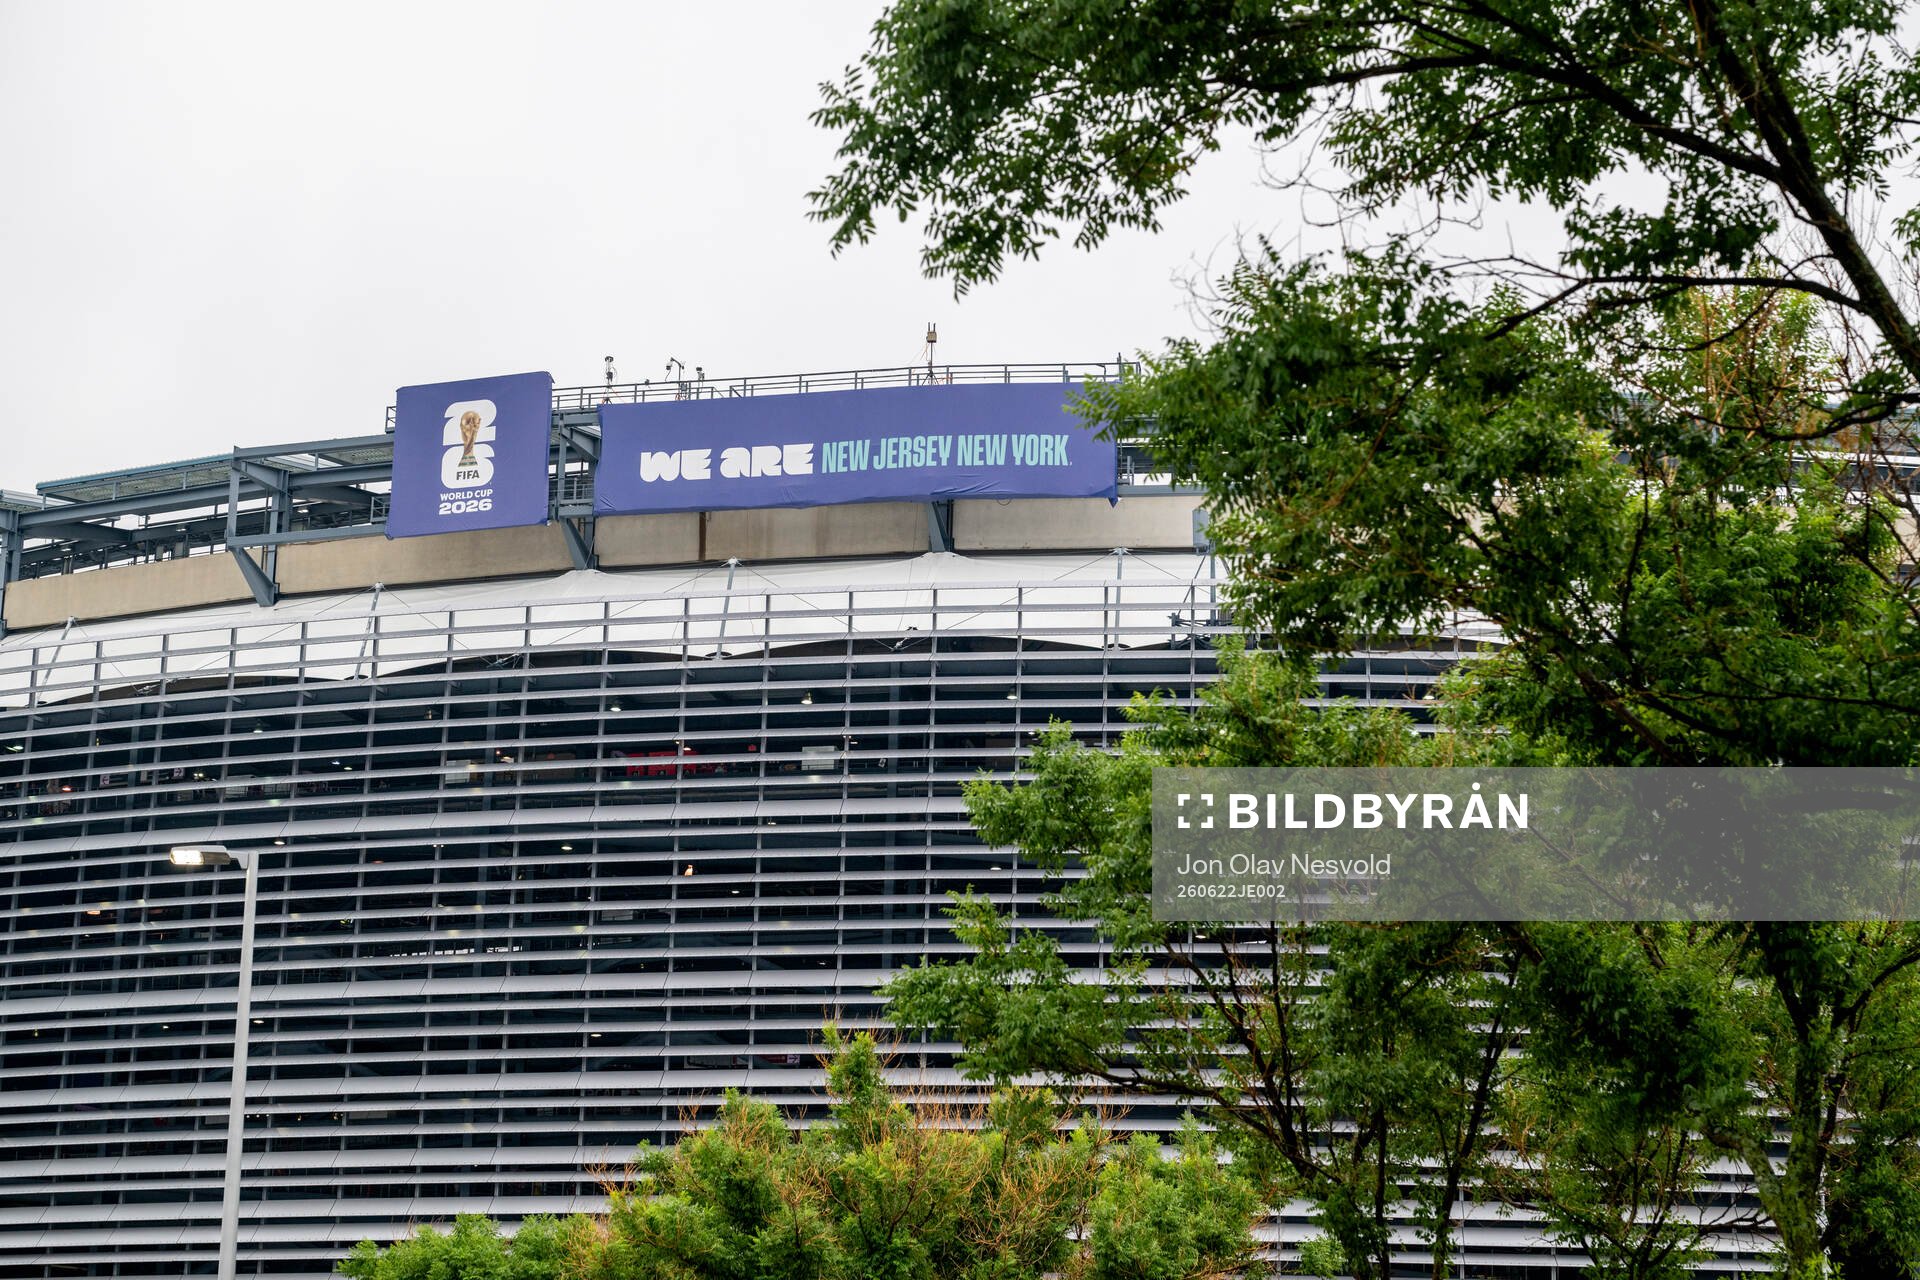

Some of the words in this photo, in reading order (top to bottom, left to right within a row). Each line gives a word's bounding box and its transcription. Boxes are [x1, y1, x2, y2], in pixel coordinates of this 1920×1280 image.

[640, 448, 712, 482] WE
[822, 440, 870, 473] NEW
[873, 435, 952, 470] JERSEY
[957, 434, 1007, 466] NEW
[1011, 434, 1069, 466] YORK
[456, 470, 480, 480] FIFA
[440, 490, 473, 500] WORLD
[474, 488, 493, 498] CUP
[439, 499, 492, 515] 2026
